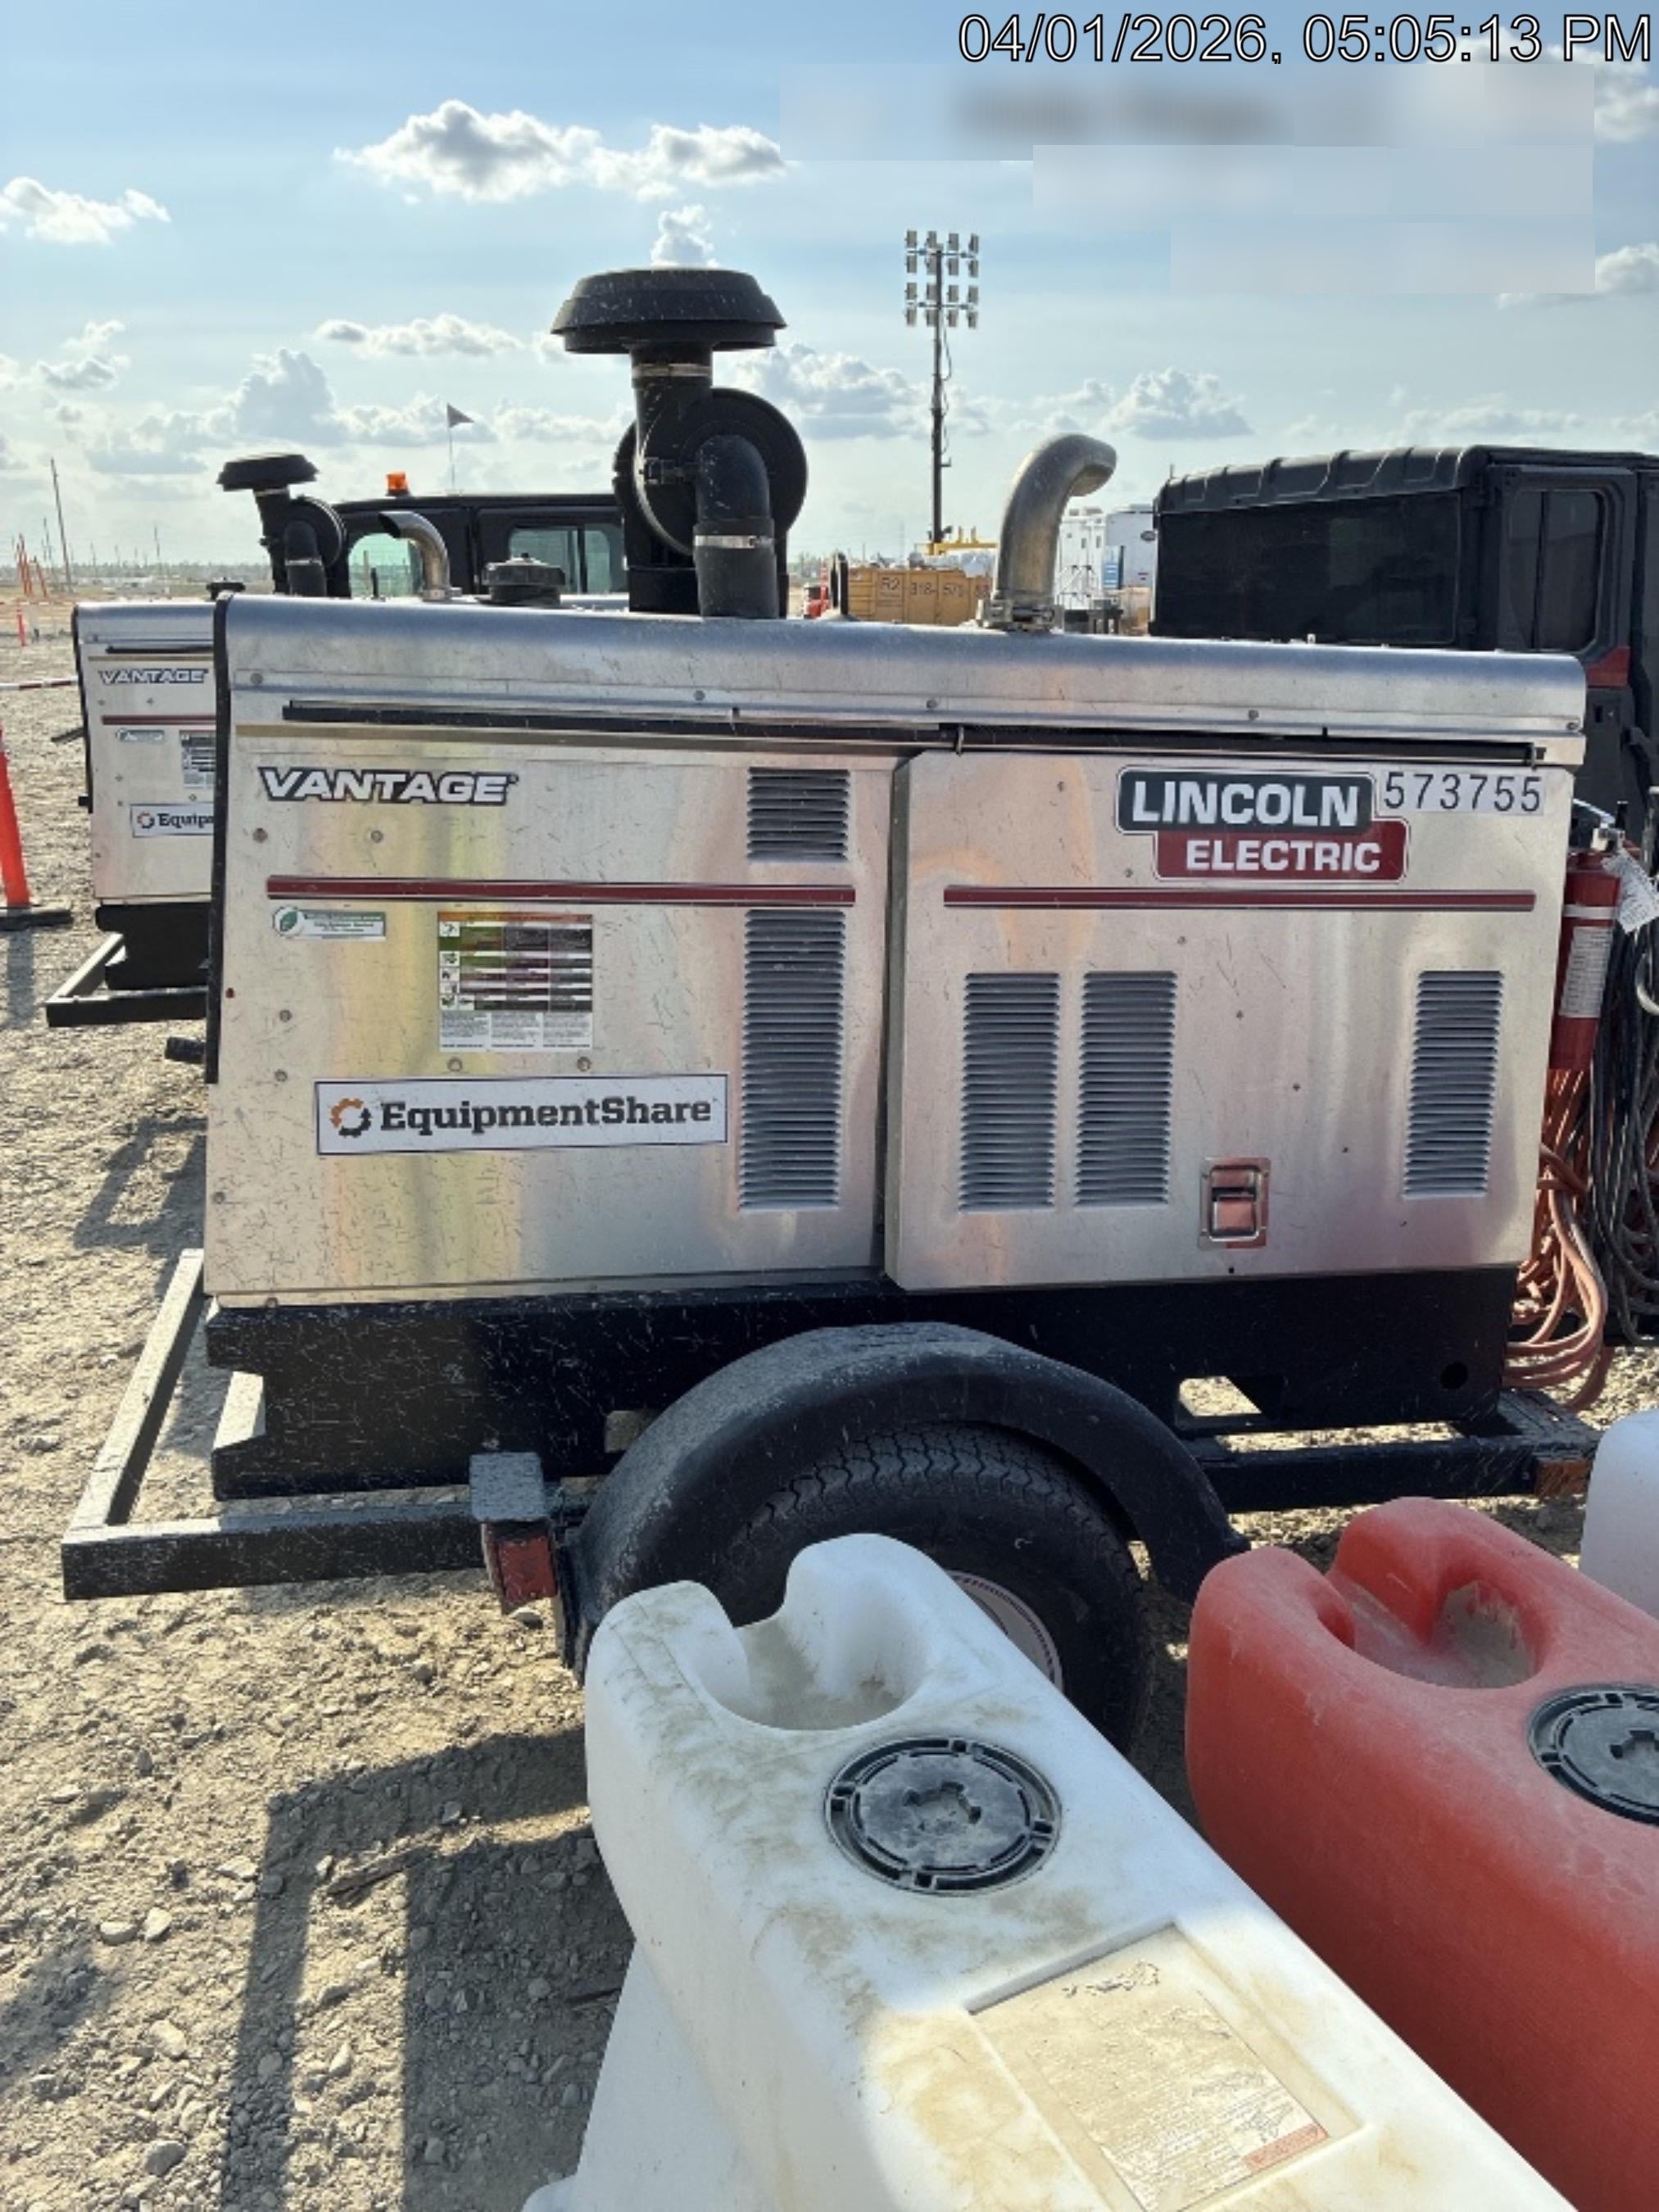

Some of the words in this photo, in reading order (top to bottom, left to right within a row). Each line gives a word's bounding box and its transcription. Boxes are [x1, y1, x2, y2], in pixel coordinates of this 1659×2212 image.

[100, 669, 206, 684] VANTAGE
[1131, 780, 1359, 827] LINCOLN
[1384, 772, 1543, 813] 573755
[1185, 839, 1382, 873] ELECTRIC
[379, 1096, 712, 1136] EquipmentShare
